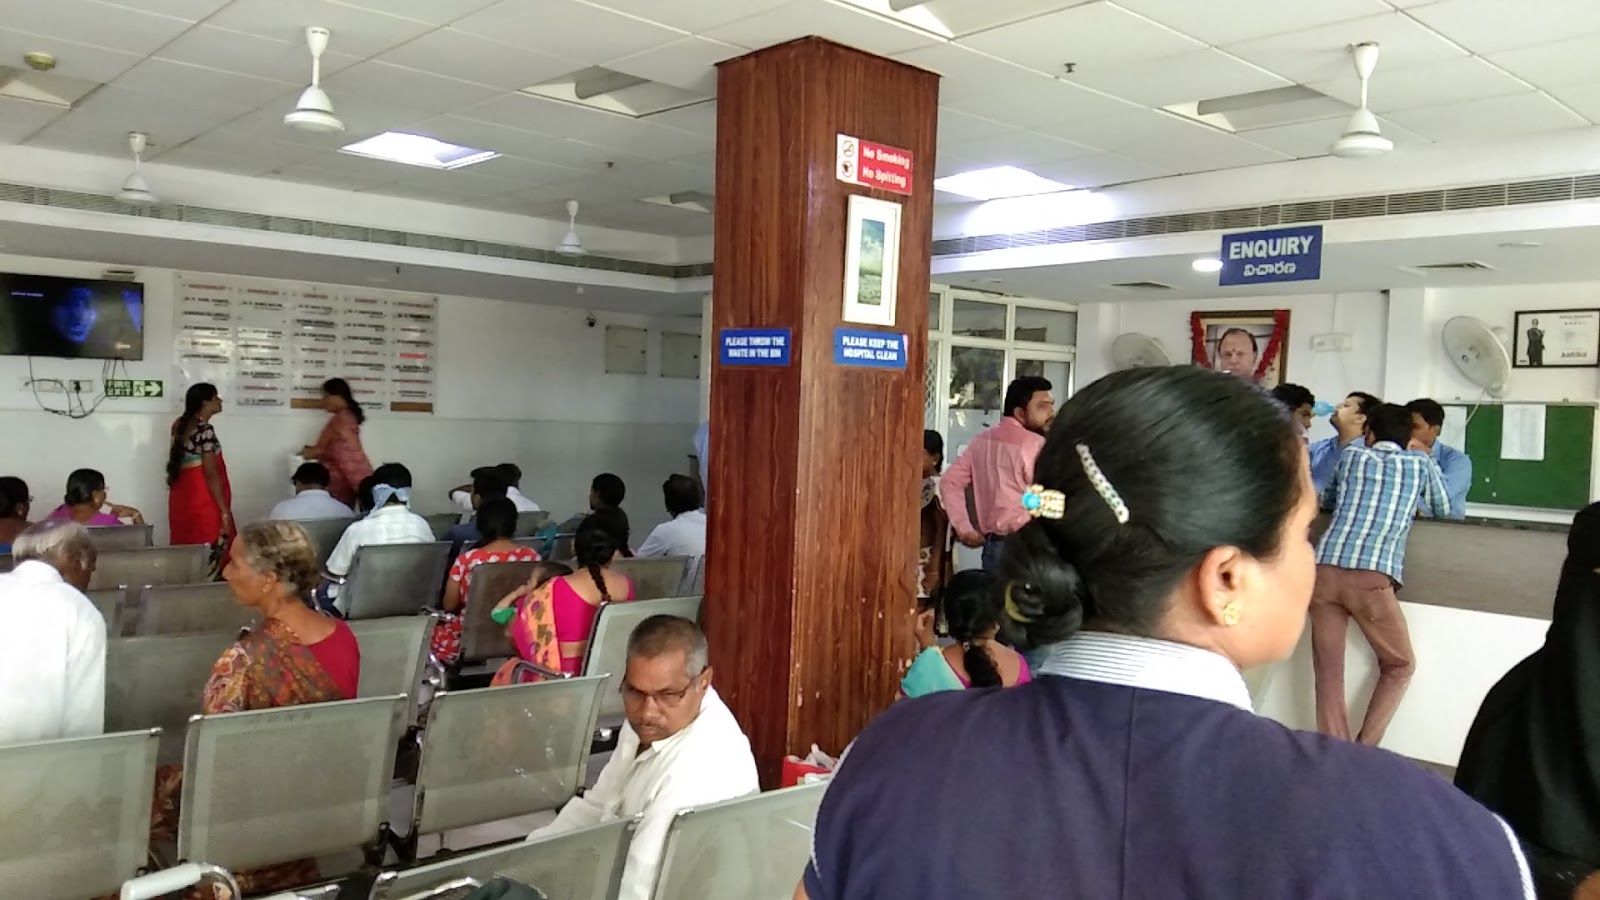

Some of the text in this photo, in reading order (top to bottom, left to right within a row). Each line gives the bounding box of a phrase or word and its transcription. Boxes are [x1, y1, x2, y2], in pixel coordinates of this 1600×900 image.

[863, 146, 910, 170] No Smoking
[862, 166, 907, 188] No Spitting
[1229, 235, 1314, 260] ENQUIRY
[1243, 261, 1297, 277] విచారణ
[725, 336, 748, 346] PLEASE
[772, 336, 785, 346] THE
[842, 336, 899, 350] PLEASE KEEP THE
[757, 348, 769, 358] THE
[843, 347, 898, 361] HOSPITAL CLEAN
[106, 388, 132, 396] EXIT
